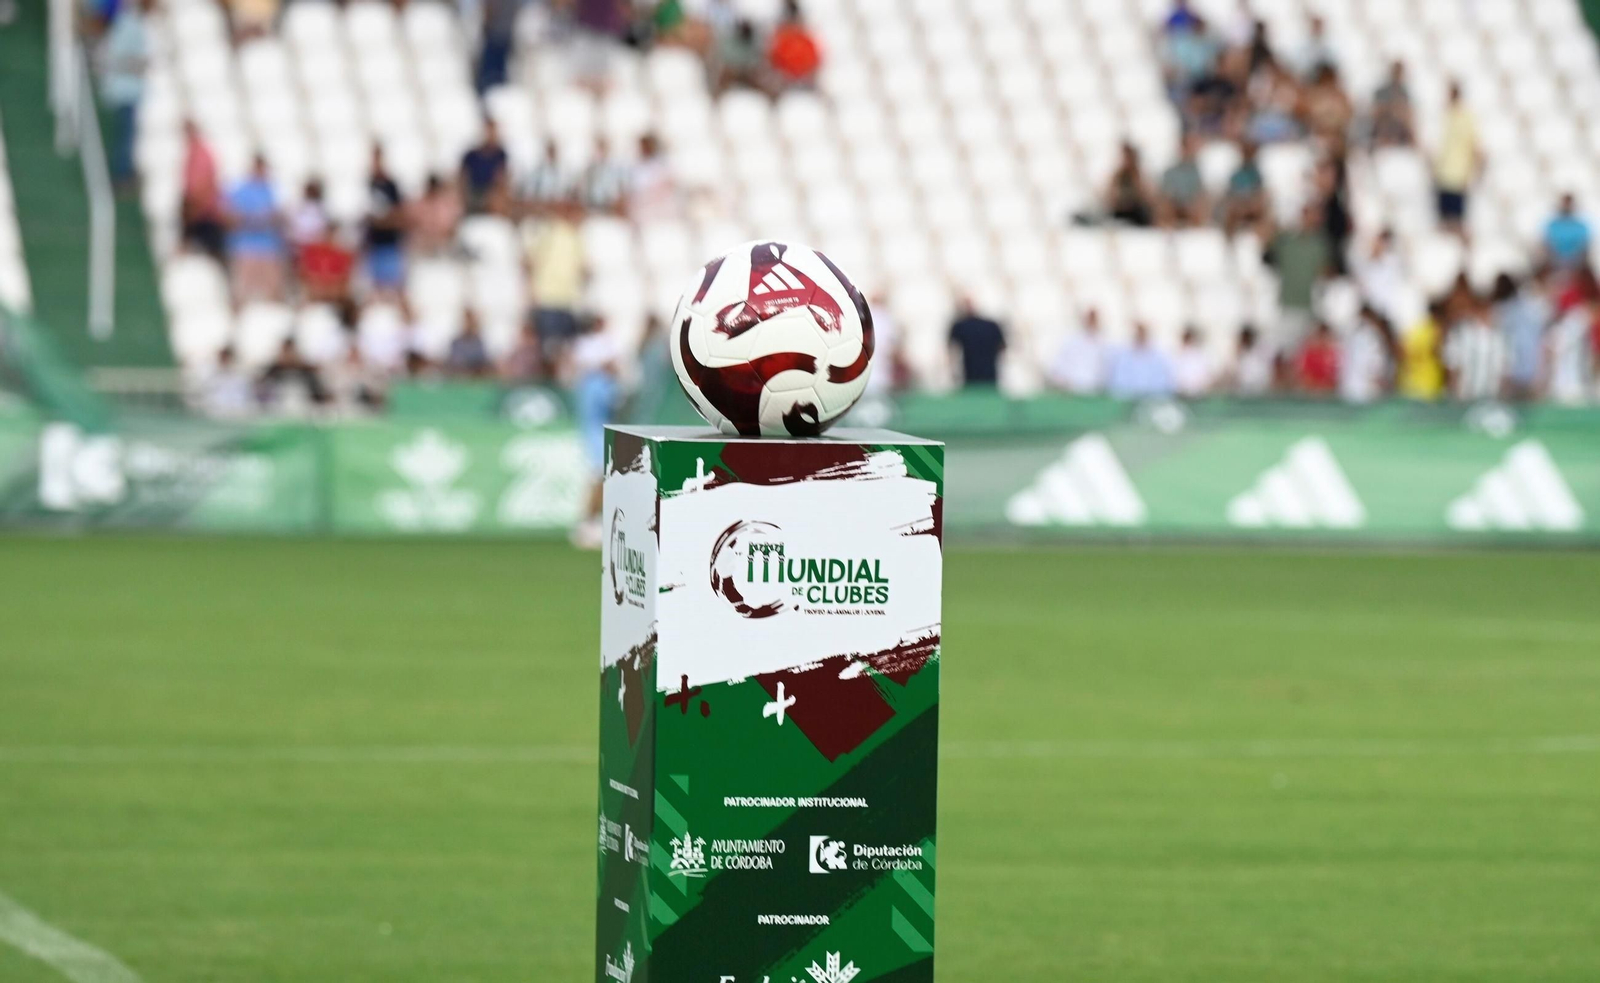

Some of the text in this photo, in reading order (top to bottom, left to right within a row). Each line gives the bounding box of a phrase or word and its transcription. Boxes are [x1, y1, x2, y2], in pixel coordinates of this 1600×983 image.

[747, 541, 889, 583] MUNDIAL
[791, 585, 889, 604] DE CLUBES
[723, 796, 869, 808] PATROCINADOR INSTITUCIONAL
[711, 839, 786, 854] AYUNTAMIENTO
[853, 844, 923, 858] Diputación
[710, 851, 774, 870] DE CÓRDOBA
[852, 857, 923, 870] de Córdoba
[757, 914, 830, 926] PATROCINADOR
